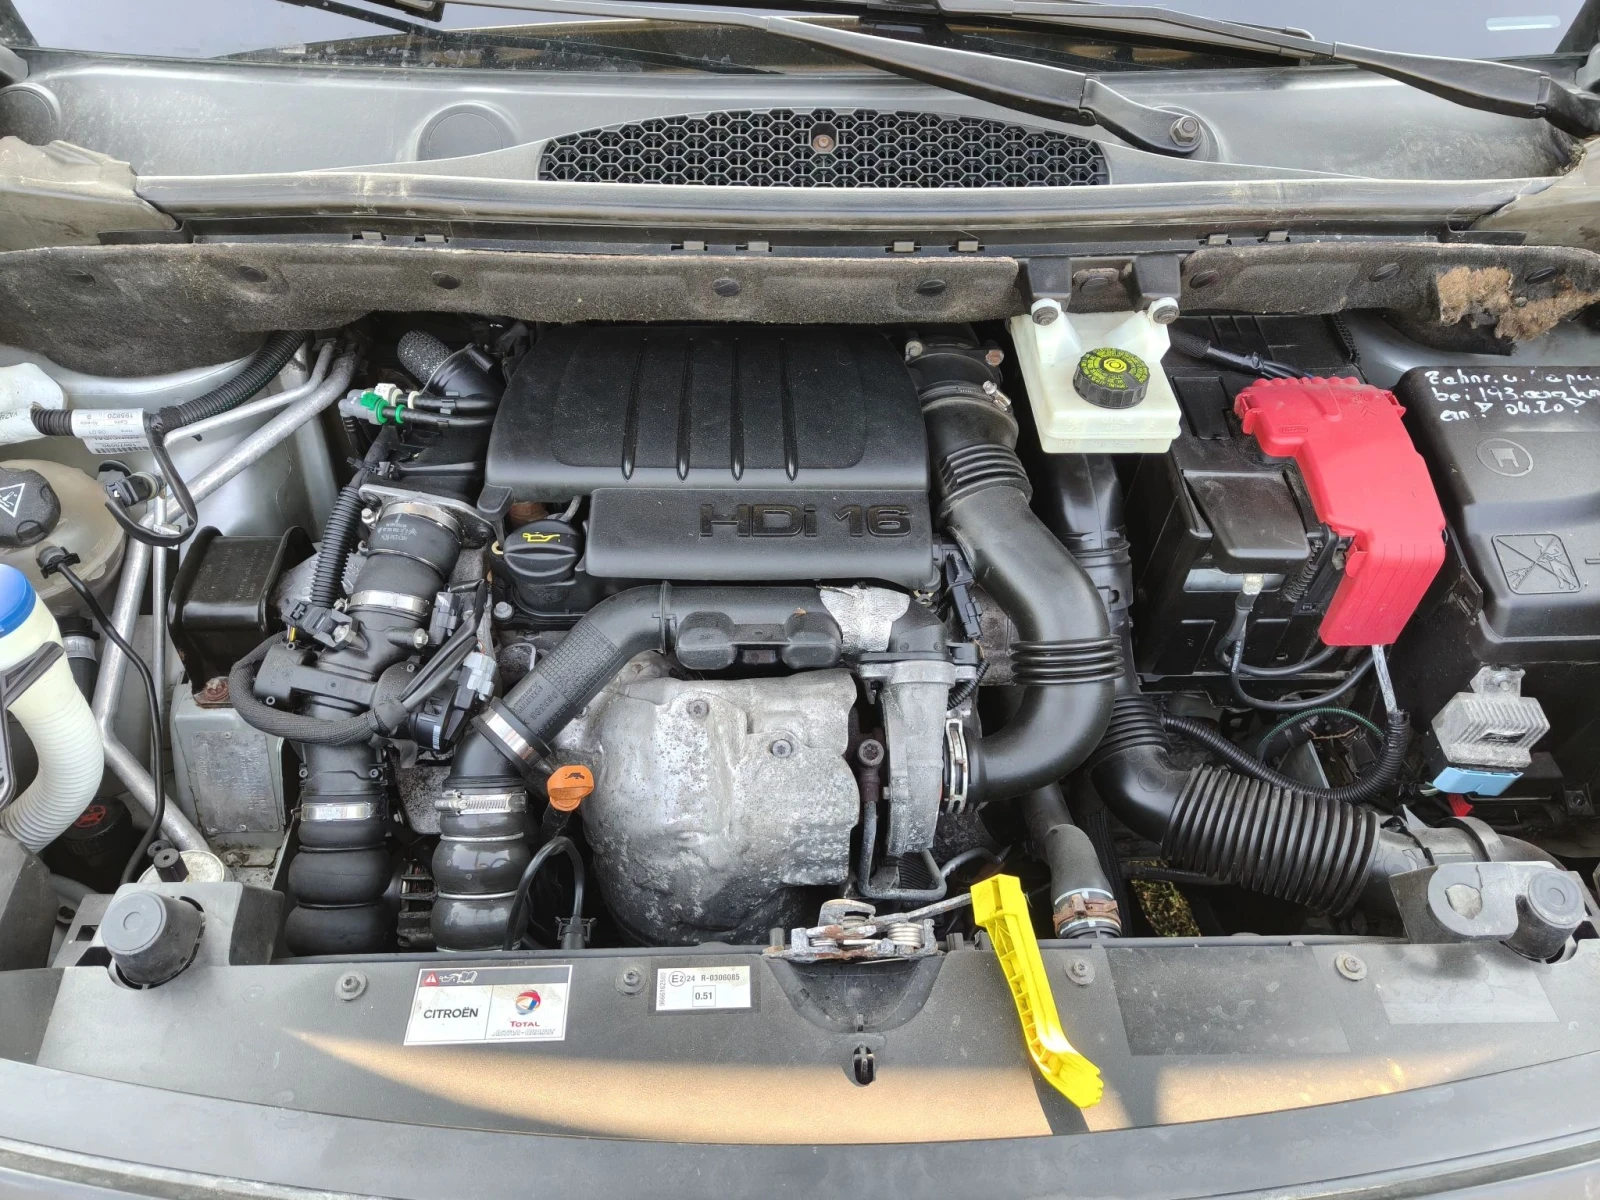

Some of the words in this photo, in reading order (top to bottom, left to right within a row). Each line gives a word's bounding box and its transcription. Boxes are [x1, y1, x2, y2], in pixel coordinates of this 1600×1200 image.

[1431, 386, 1471, 402] bei
[1569, 385, 1600, 400] km
[699, 503, 818, 538] HDi
[834, 503, 912, 538] 16
[686, 974, 696, 982] 24
[694, 991, 713, 1000] 0.51
[423, 1006, 480, 1019] CITROËN
[510, 1020, 541, 1028] TOTAL
